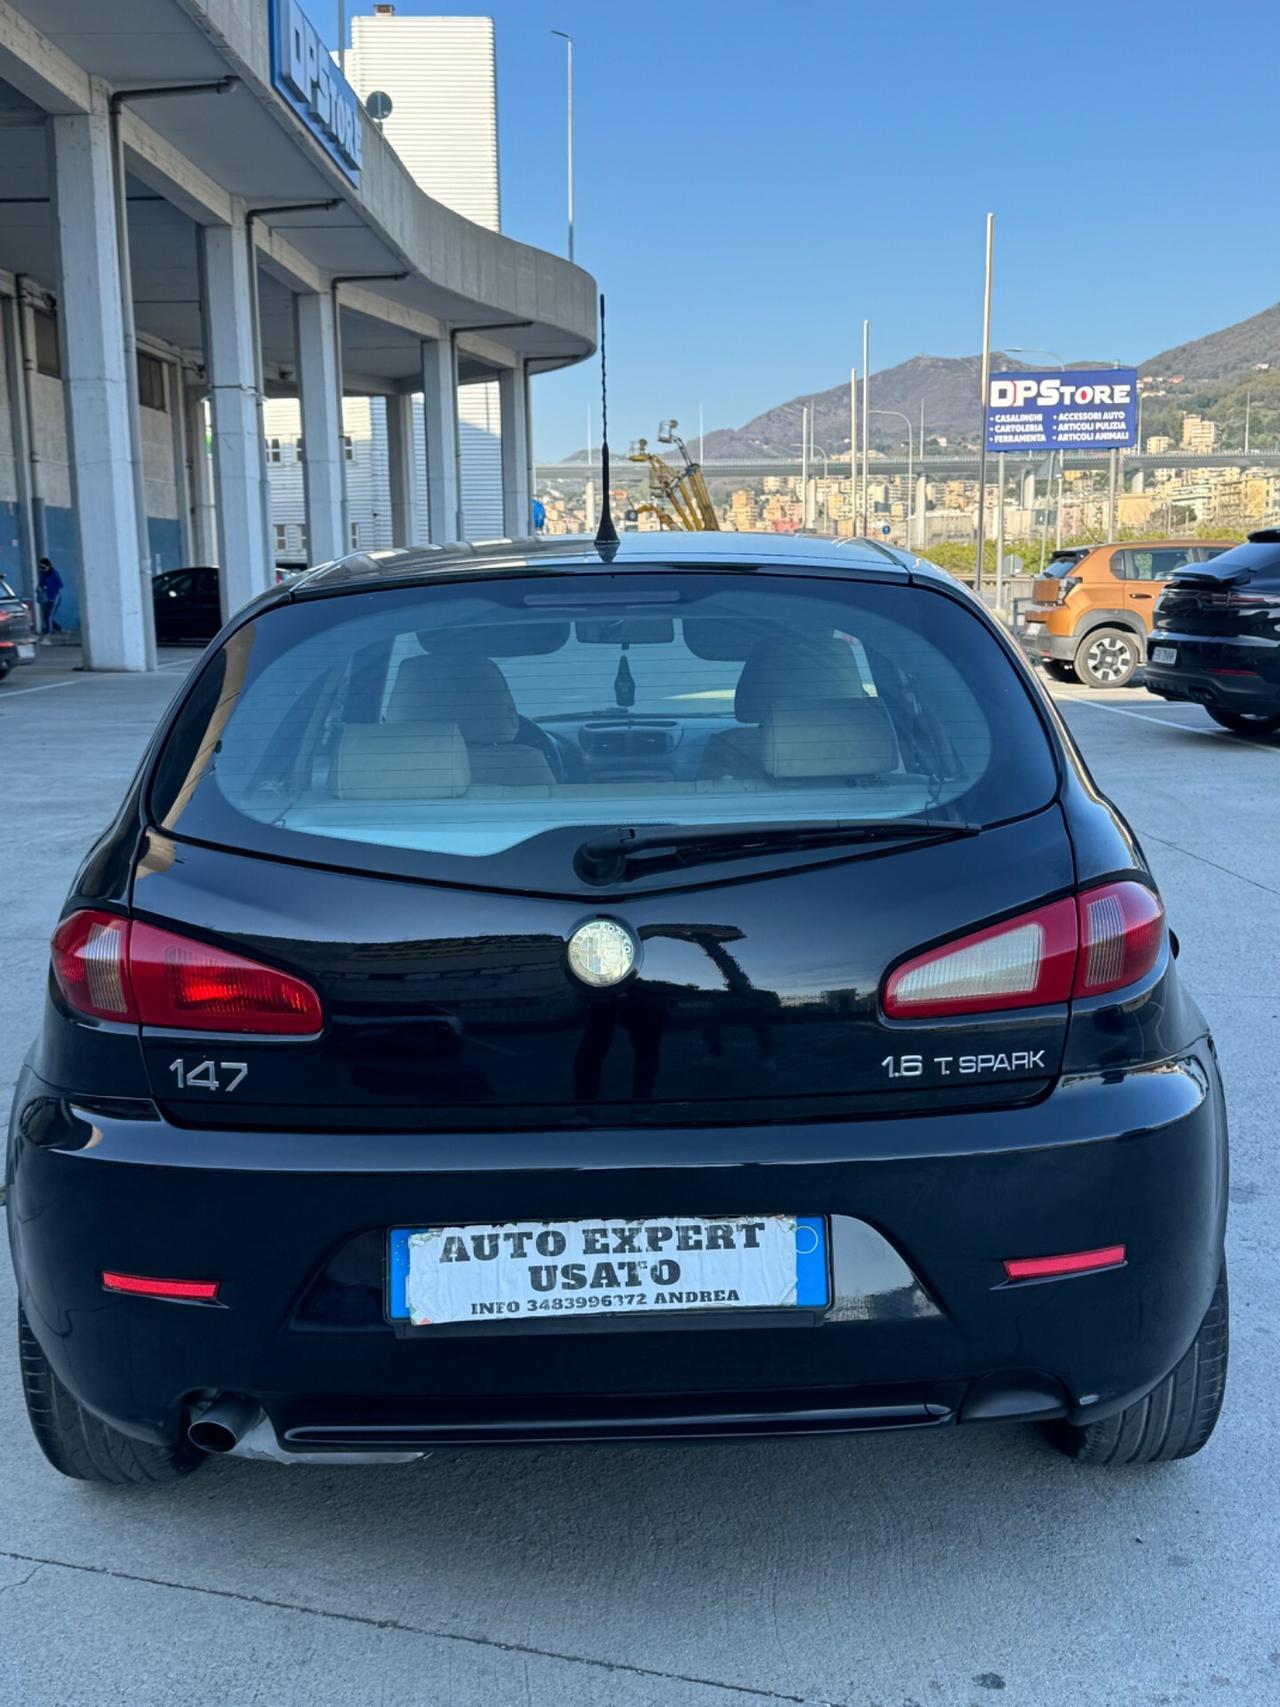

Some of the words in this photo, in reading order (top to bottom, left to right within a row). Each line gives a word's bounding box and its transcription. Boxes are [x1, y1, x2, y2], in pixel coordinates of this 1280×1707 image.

[995, 414, 1043, 423] CASALINGHI
[1058, 412, 1102, 422] ACCESSORI
[1103, 411, 1125, 420] AUTO
[995, 424, 1044, 433] CARTOLERIA
[1058, 422, 1094, 432] ARTICOLI
[1095, 421, 1127, 430] PULIZIA
[994, 434, 1046, 443] FERRAMENTA
[1057, 432, 1094, 442] ARTICOLI
[1095, 432, 1129, 441] ANIMALI
[881, 1055, 923, 1078] 1.6
[169, 1058, 248, 1092] 147
[439, 1229, 567, 1264] AUTO
[582, 1223, 765, 1256] EXPERT
[528, 1259, 681, 1293] USATO
[471, 1300, 520, 1316] INFO
[527, 1292, 647, 1312] 3483996372
[654, 1288, 740, 1306] ANDREA
